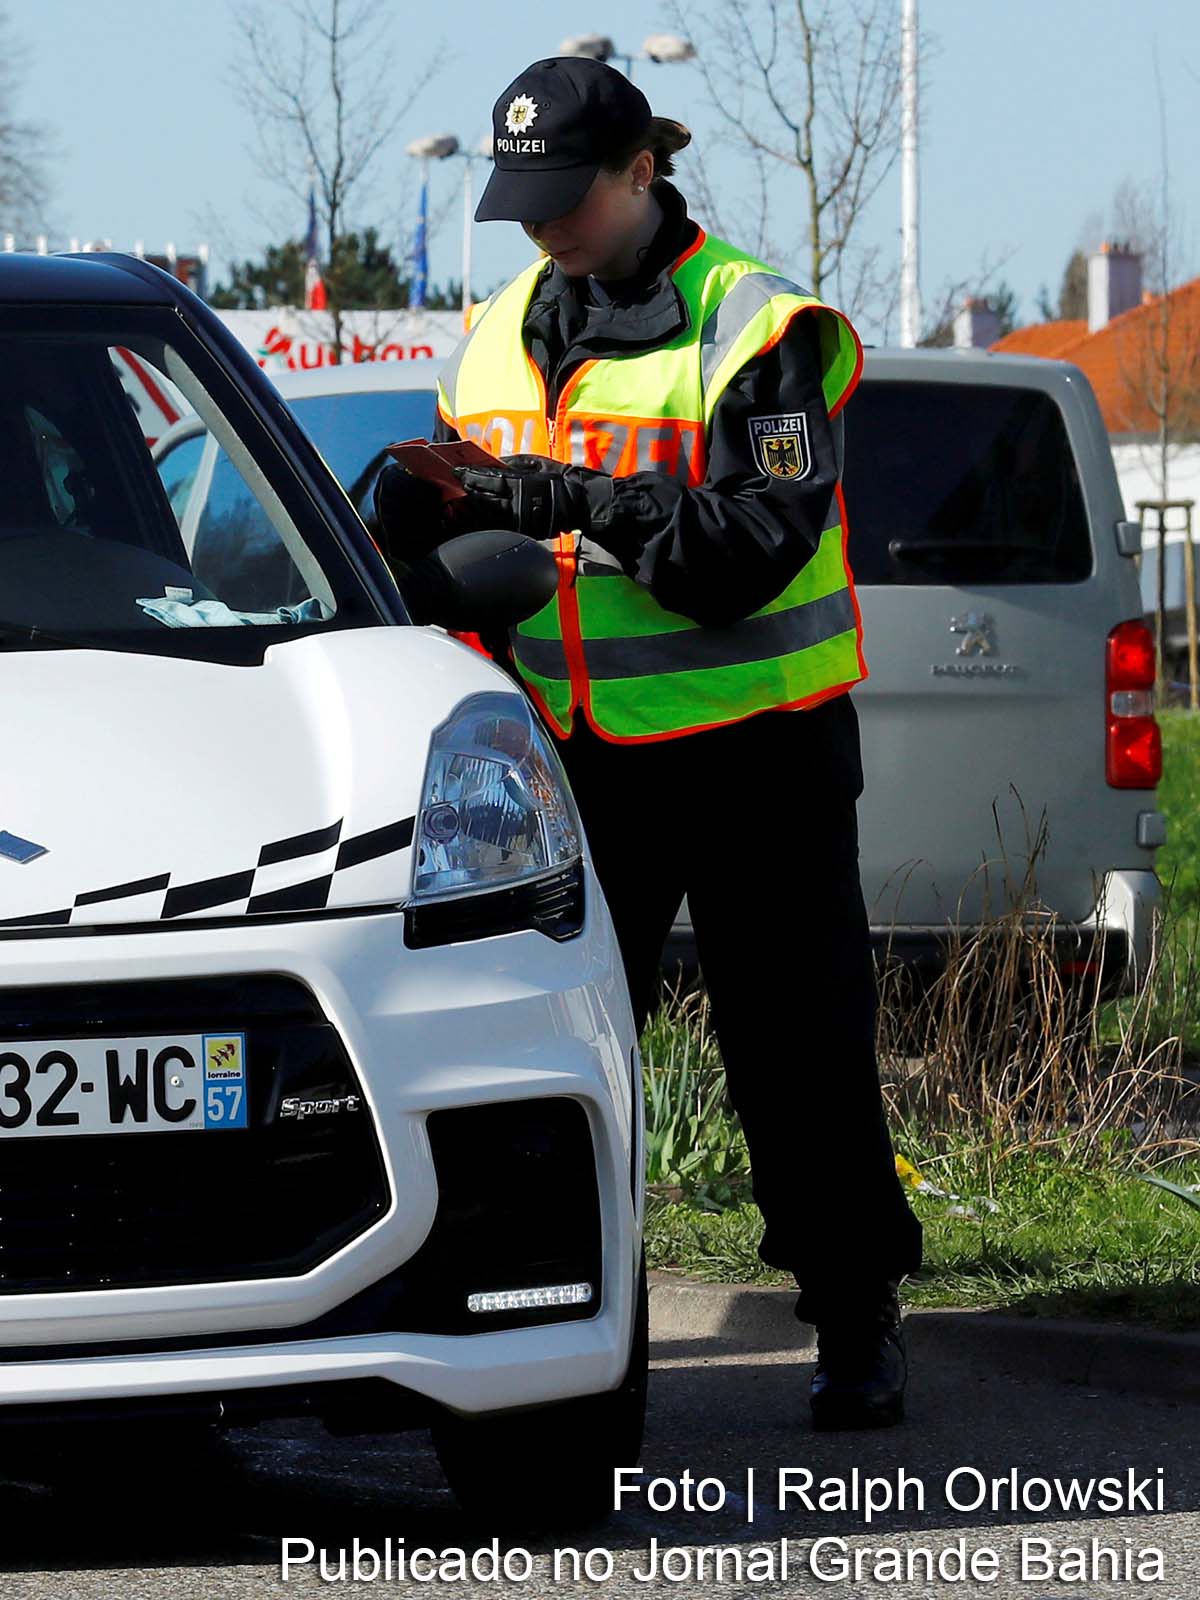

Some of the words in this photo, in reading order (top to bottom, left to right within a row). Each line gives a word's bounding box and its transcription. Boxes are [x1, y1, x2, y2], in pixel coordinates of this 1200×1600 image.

[497, 138, 546, 154] POLIZEI
[753, 417, 802, 435] POLIZEI
[207, 1070, 242, 1079] lorraine
[207, 1085, 243, 1122] 57
[280, 1095, 360, 1120] Sport
